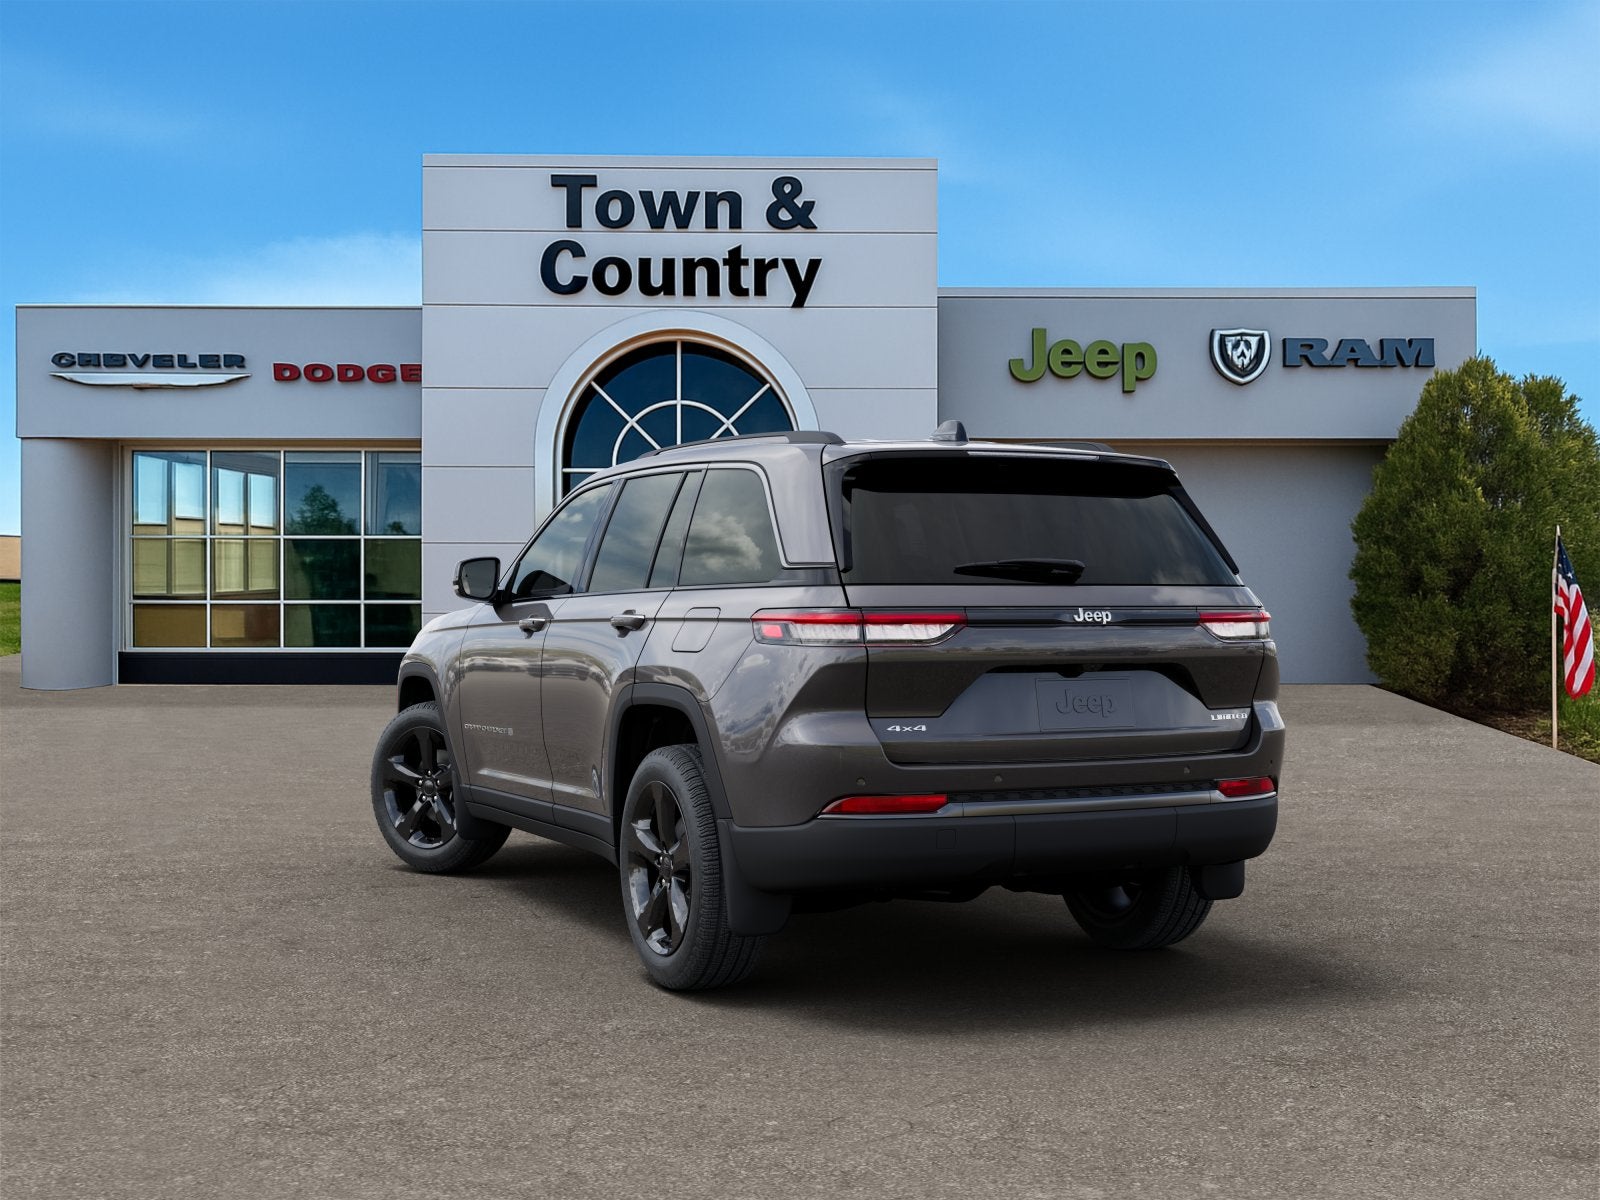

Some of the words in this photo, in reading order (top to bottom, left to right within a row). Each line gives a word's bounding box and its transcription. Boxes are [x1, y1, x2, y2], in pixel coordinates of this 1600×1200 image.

[551, 174, 742, 230] Town
[765, 176, 818, 230] &
[540, 240, 822, 308] Country
[1009, 328, 1157, 392] Jeep
[1282, 337, 1435, 368] RAM
[273, 363, 422, 383] DODGE
[1073, 608, 1112, 624] Jeep
[1056, 688, 1115, 718] Jeep
[886, 724, 927, 732] 4x4
